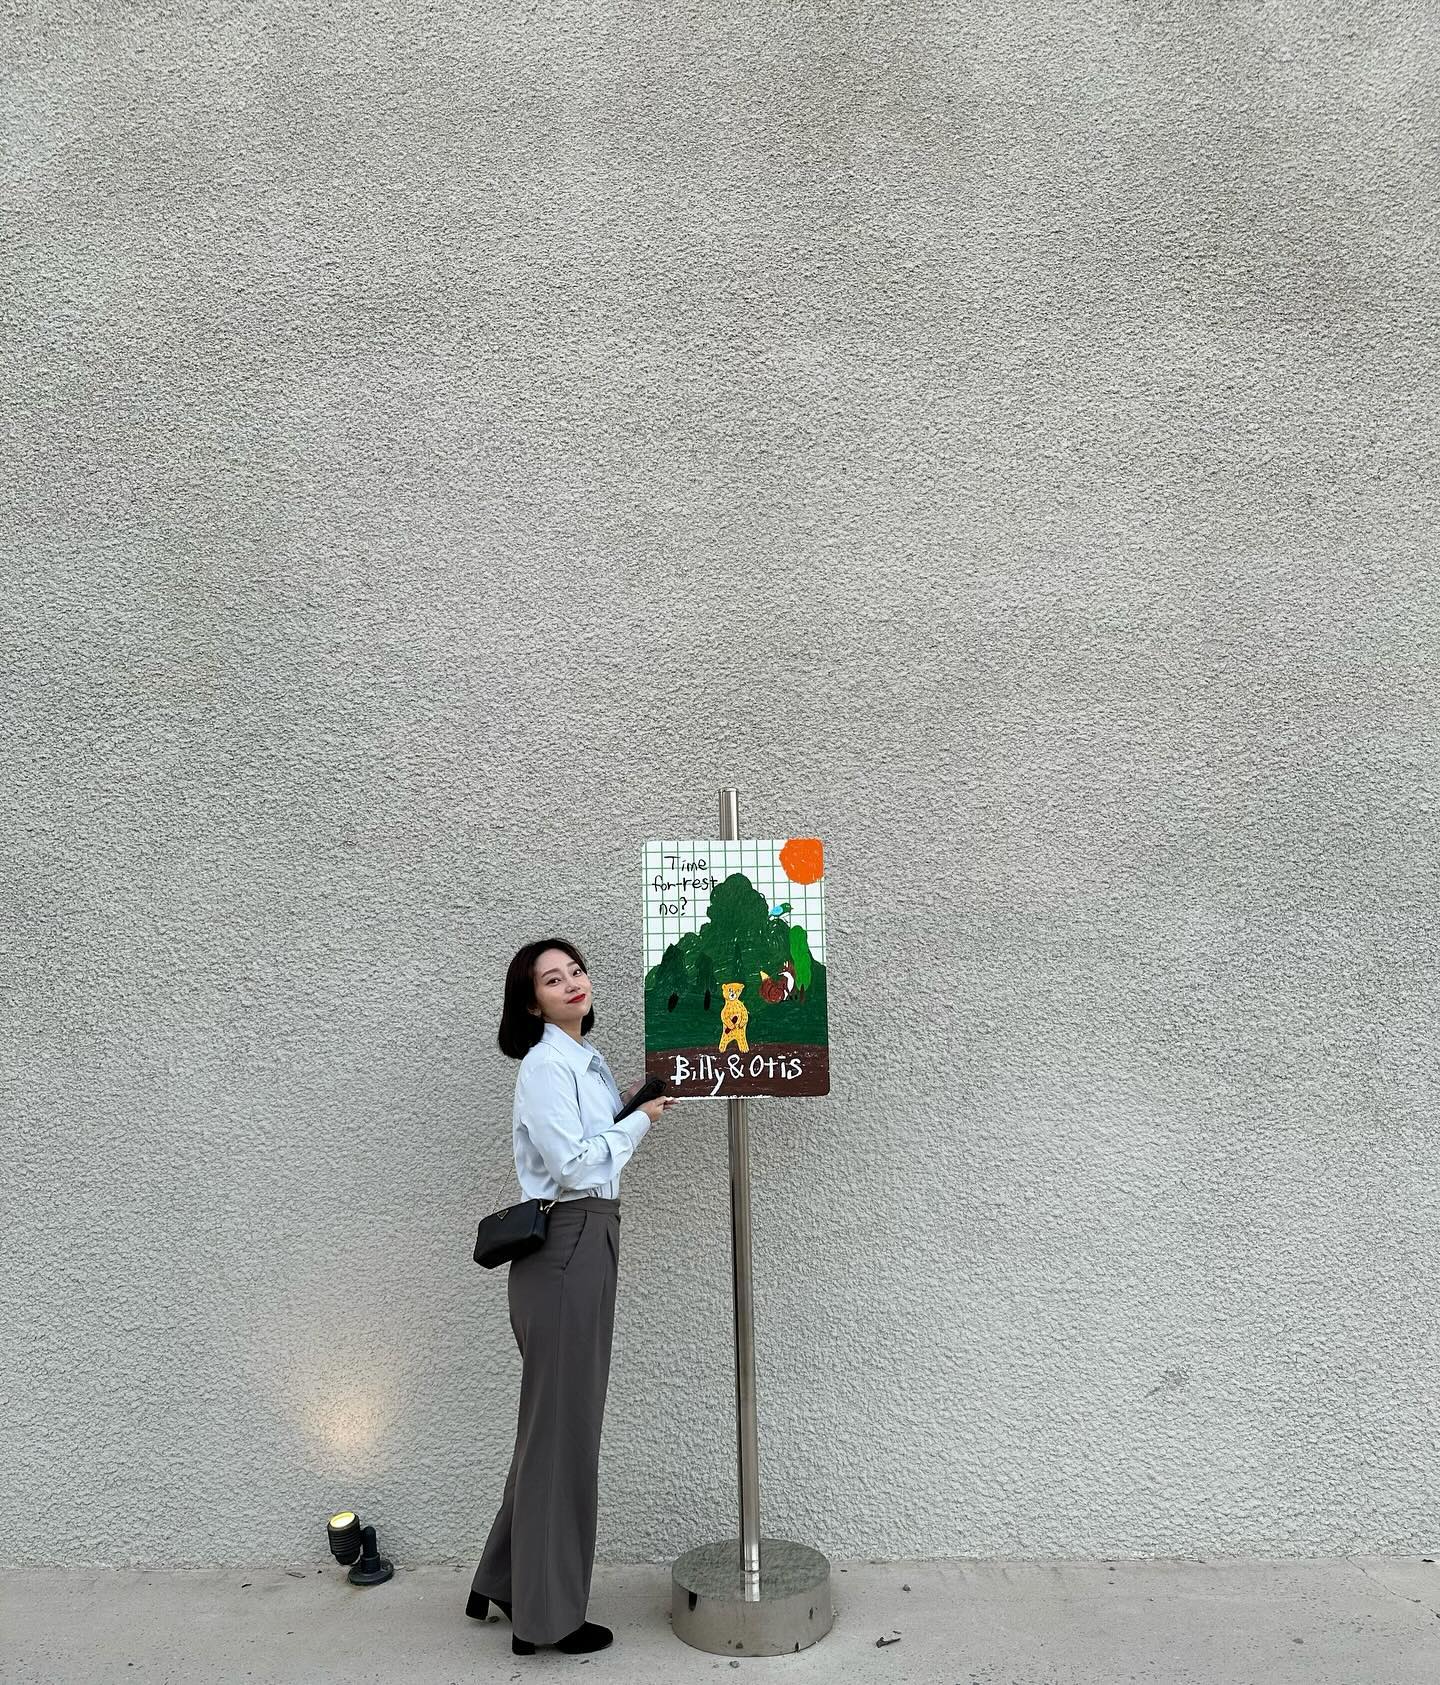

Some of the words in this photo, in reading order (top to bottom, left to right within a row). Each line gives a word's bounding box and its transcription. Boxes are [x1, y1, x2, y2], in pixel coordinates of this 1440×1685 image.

[664, 856, 708, 872] Time
[659, 897, 688, 916] no?
[669, 1054, 725, 1096] Billy
[727, 1054, 744, 1079] &
[750, 1054, 802, 1079] Otis
